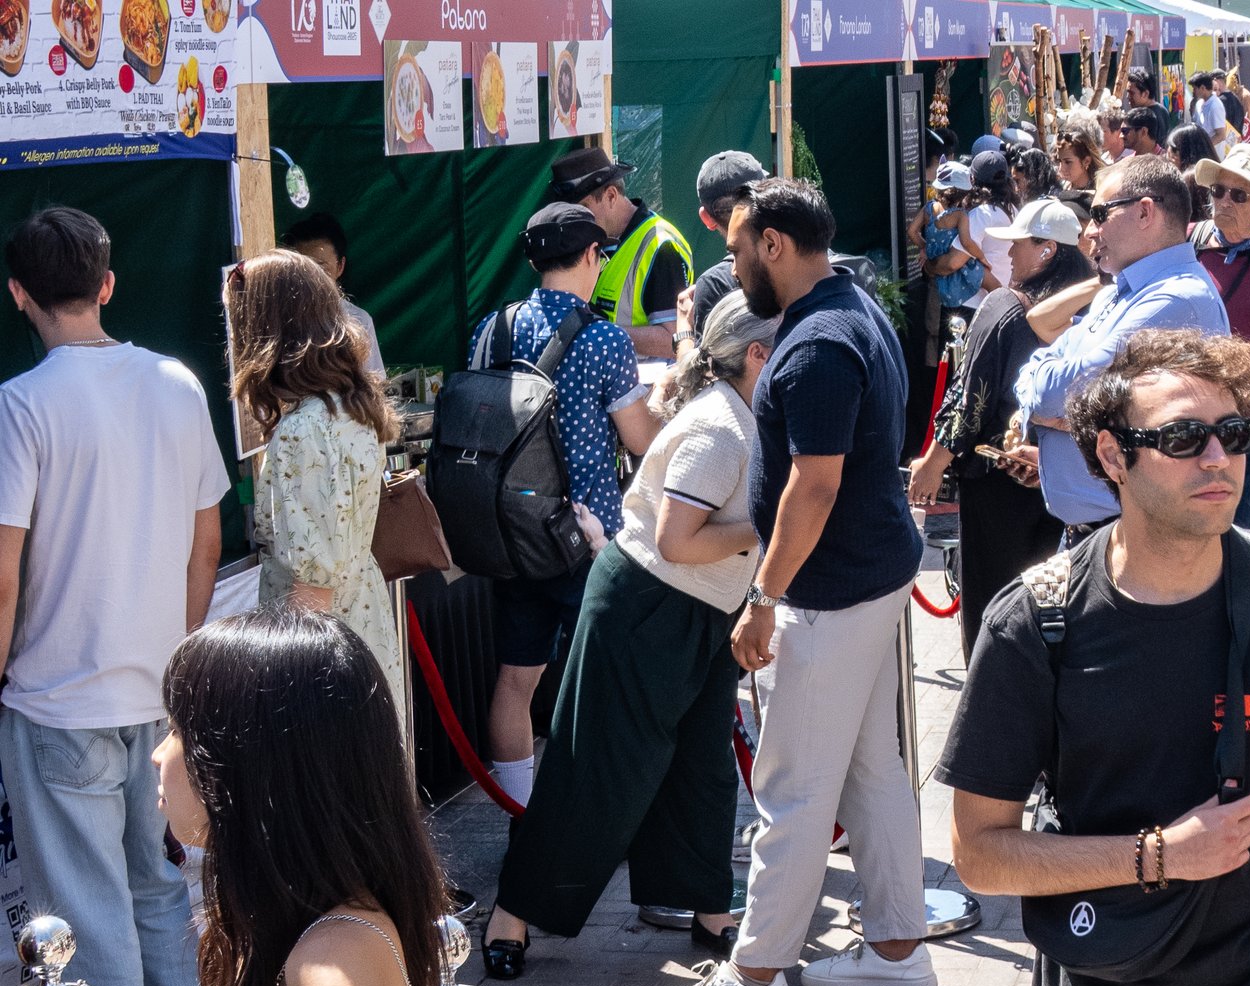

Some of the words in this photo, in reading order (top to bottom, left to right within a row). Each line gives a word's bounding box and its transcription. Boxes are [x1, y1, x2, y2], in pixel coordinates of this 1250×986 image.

[442, 0, 487, 30] Patara
[856, 14, 872, 35] London
[175, 39, 188, 53] spicy
[189, 40, 205, 51] noodle
[206, 41, 217, 53] soup
[6, 82, 24, 97] Belly
[25, 81, 42, 95] Pork
[59, 79, 65, 92] 4.
[65, 79, 85, 94] Crispy
[85, 78, 100, 92] Belly
[100, 78, 115, 91] Pork
[66, 97, 80, 110] with
[81, 97, 94, 111] BBQ
[94, 96, 111, 108] Sauce
[138, 93, 149, 104] PAD
[149, 93, 164, 104] THAI
[7, 101, 13, 115] &
[14, 100, 31, 114] Basil
[32, 101, 52, 113] Sauce
[120, 110, 134, 122] With
[207, 115, 221, 126] noodle
[55, 147, 94, 160] information
[94, 143, 123, 156] available
[123, 145, 140, 158] upon
[139, 143, 160, 155] request
